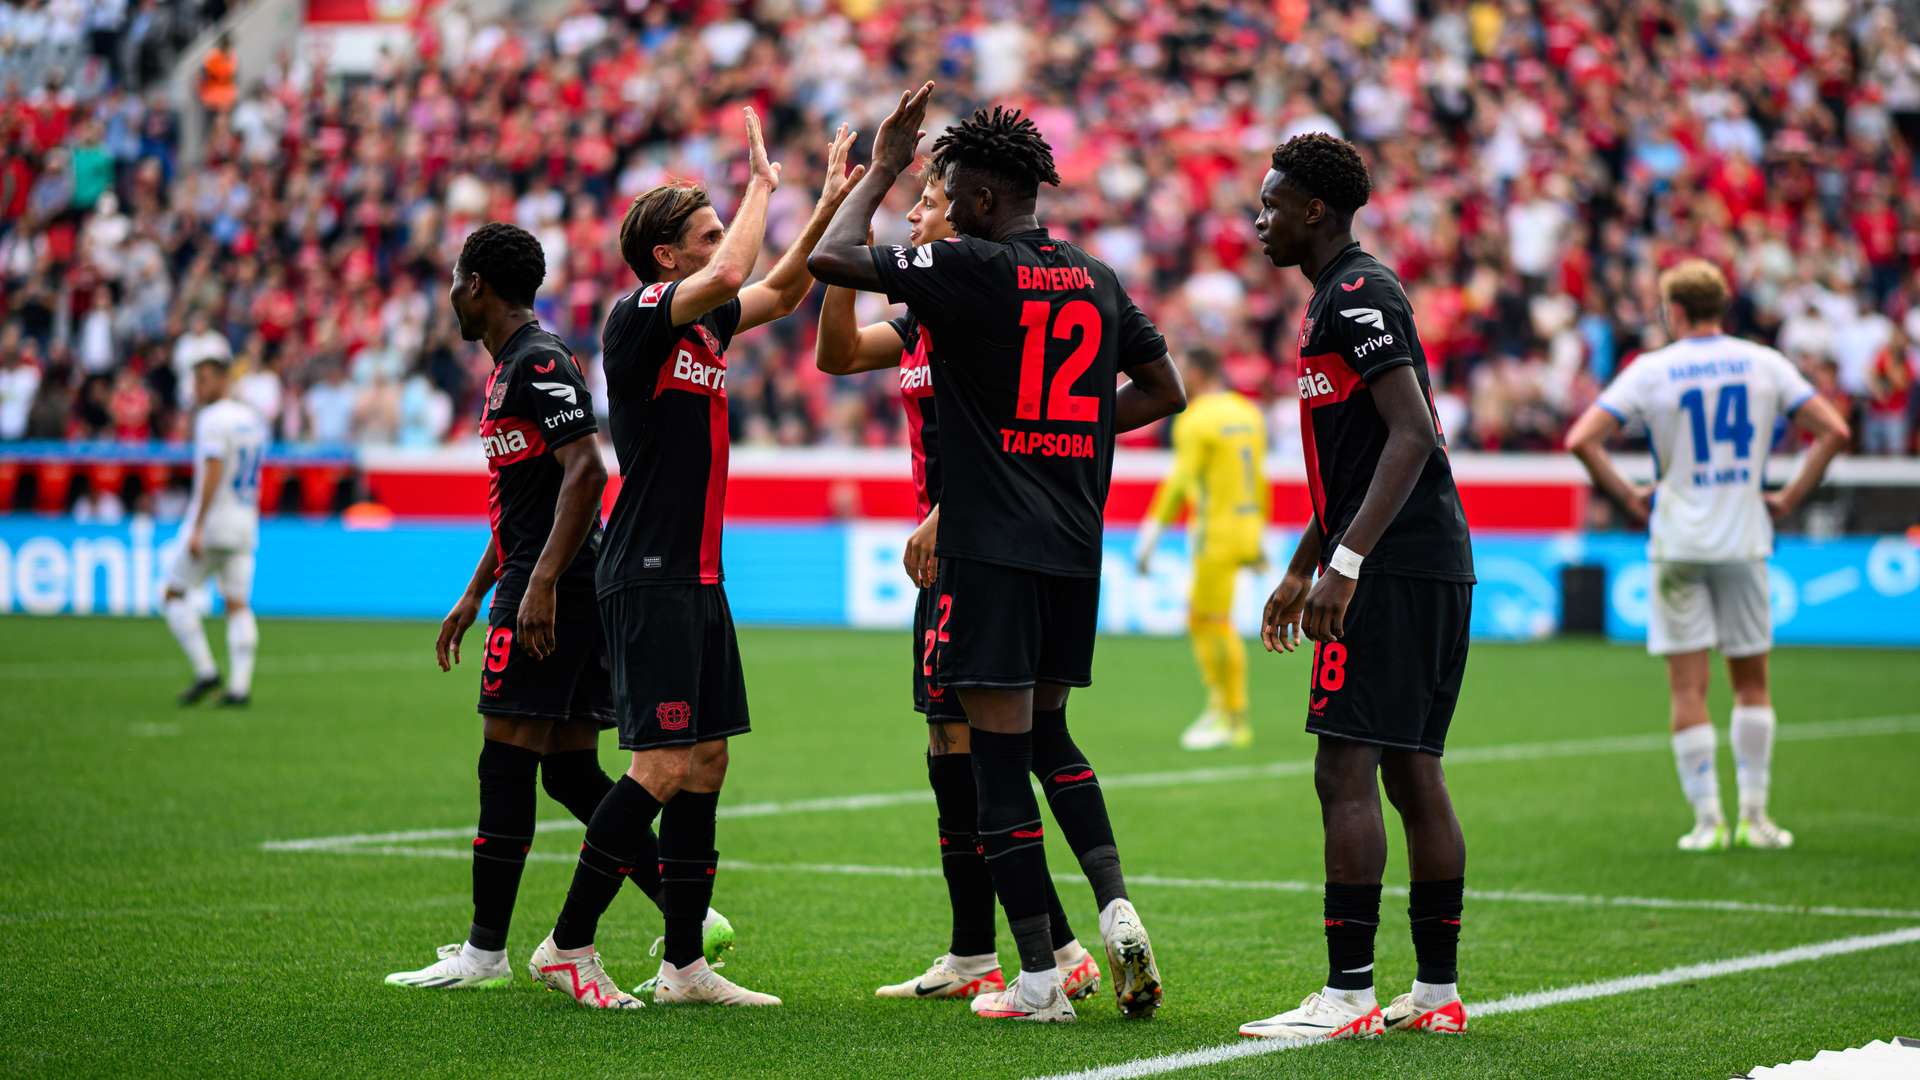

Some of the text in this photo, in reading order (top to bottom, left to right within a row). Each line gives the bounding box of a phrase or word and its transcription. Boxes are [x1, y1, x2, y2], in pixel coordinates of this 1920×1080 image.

[1017, 265, 1095, 291] BAYER04
[1015, 300, 1102, 422] 12
[1354, 334, 1394, 358] trive
[544, 408, 585, 429] trive
[1680, 384, 1755, 462] 14
[1000, 428, 1094, 458] TAPSOBA
[923, 629, 941, 676] 2
